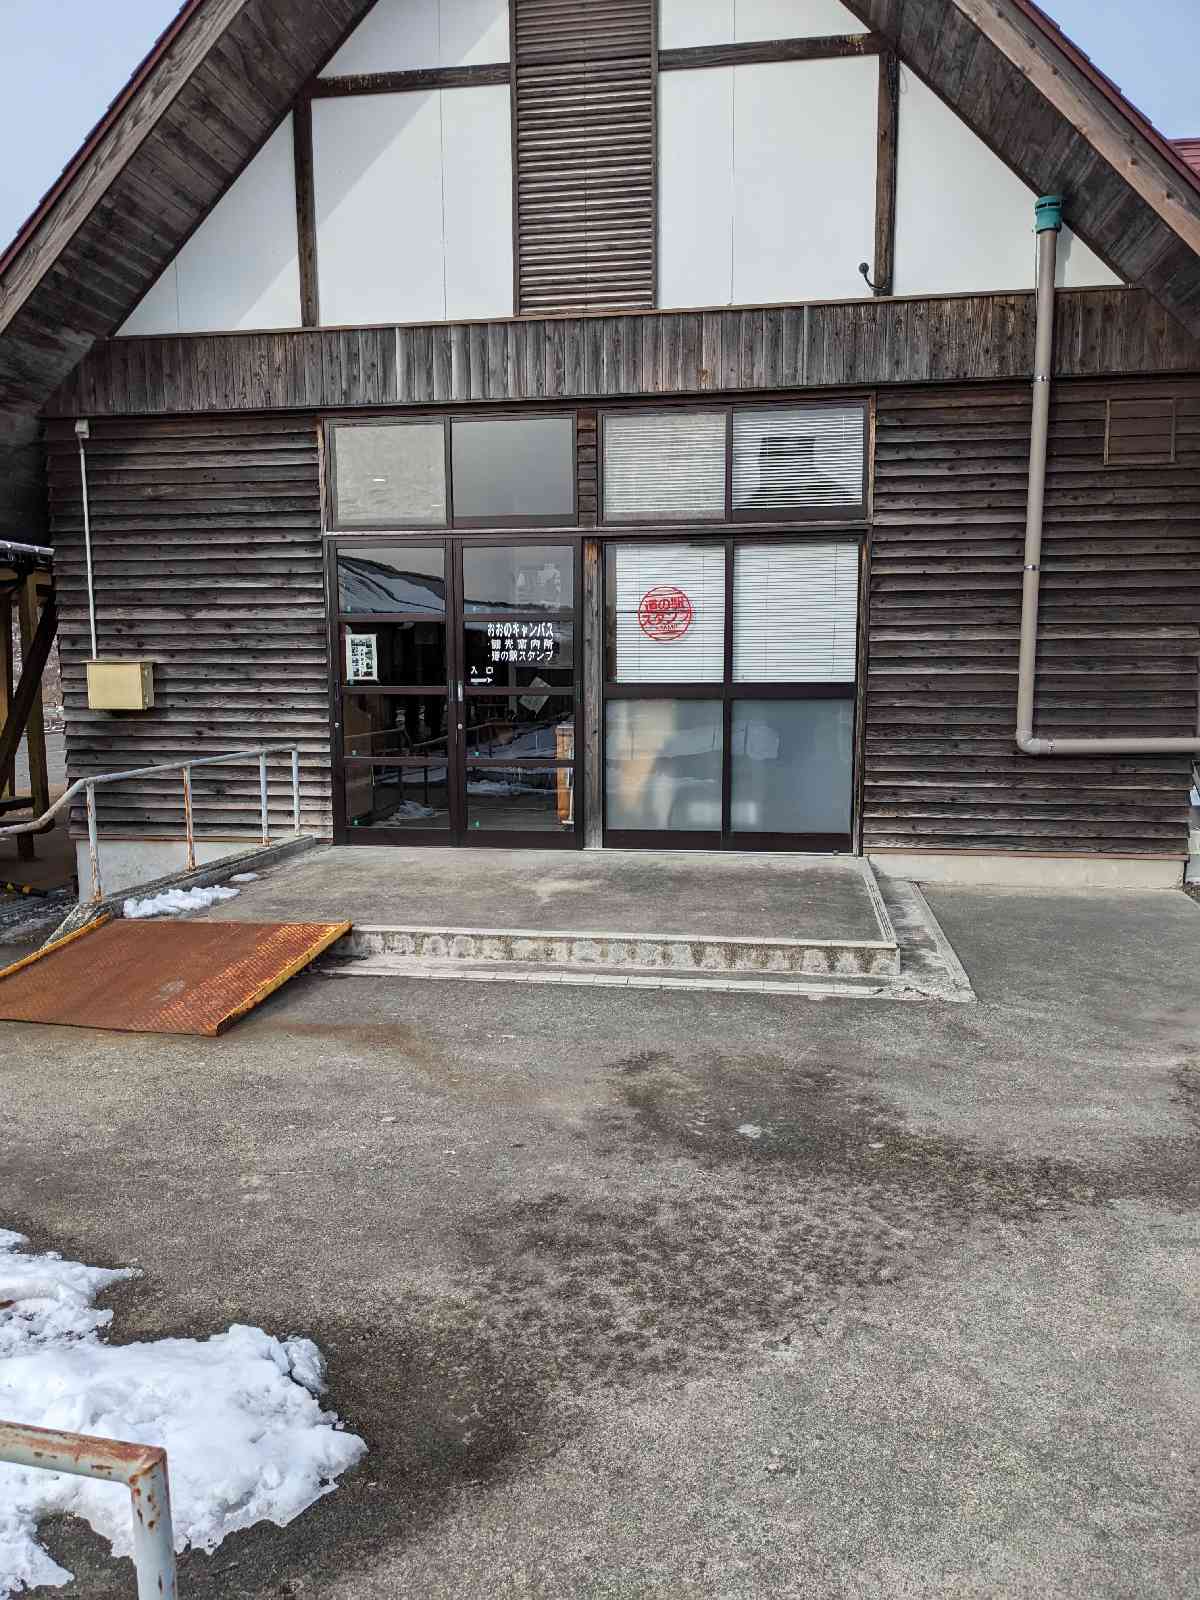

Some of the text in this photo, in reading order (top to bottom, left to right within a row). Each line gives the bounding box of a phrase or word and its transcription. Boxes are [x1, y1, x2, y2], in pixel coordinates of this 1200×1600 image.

[487, 622, 554, 638] おおのキャンバス
